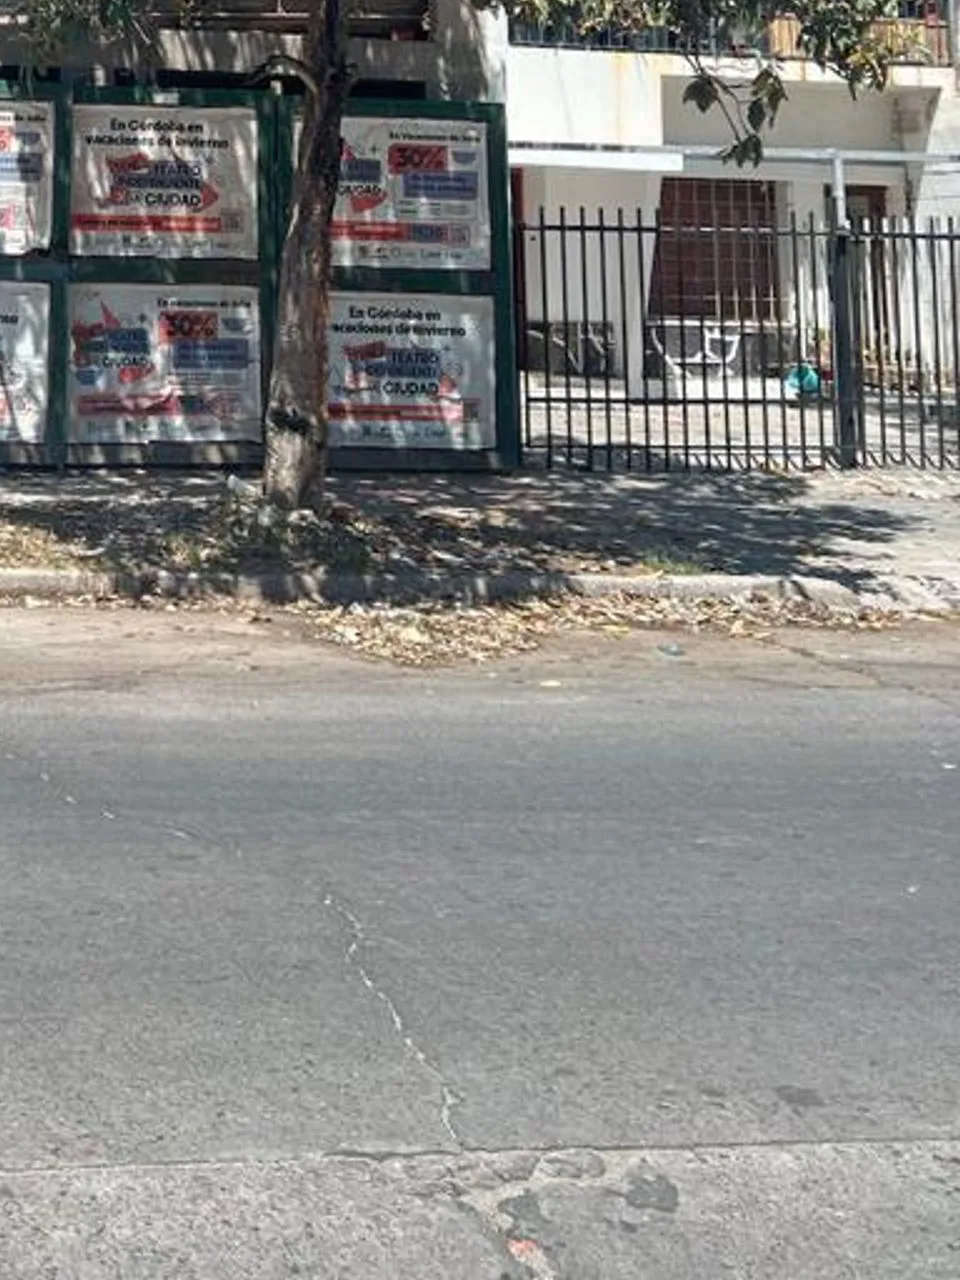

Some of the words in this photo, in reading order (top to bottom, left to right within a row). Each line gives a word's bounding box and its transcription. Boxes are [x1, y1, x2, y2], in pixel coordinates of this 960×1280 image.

[110, 118, 125, 131] En
[188, 122, 203, 132] en
[158, 136, 173, 148] de
[175, 137, 229, 149] invierno
[144, 193, 202, 207] CIUDAD
[349, 305, 363, 319] En
[425, 310, 441, 321] en
[332, 323, 392, 334] acaciones
[396, 324, 408, 334] de
[391, 351, 439, 364] TEATRO
[382, 381, 439, 395] CIUDAD
